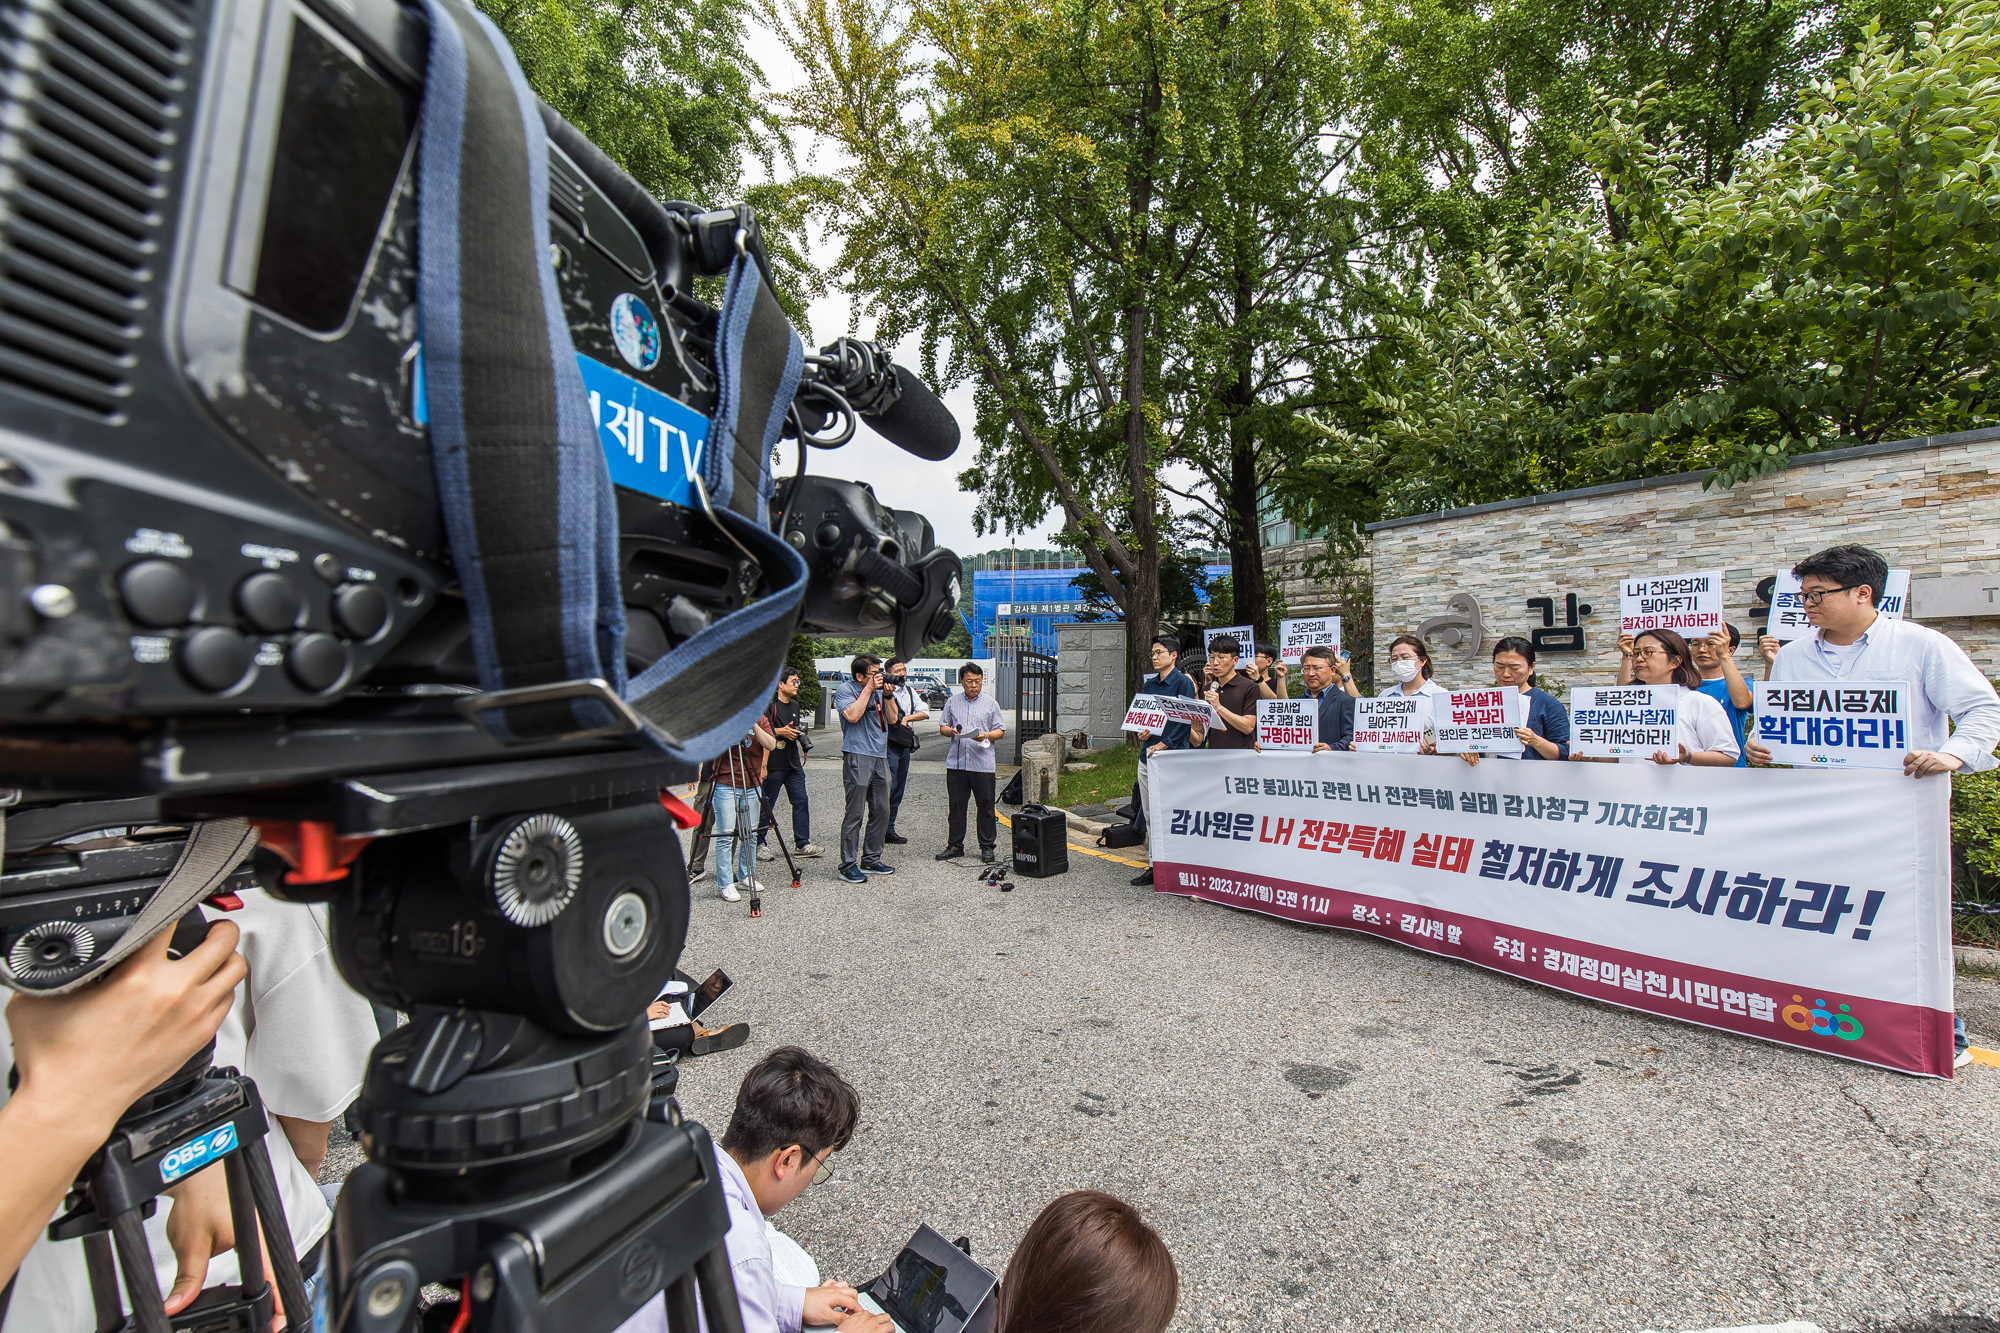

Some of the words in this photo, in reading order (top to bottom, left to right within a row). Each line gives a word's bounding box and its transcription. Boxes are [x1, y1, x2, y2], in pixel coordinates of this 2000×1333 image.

[1627, 583, 1647, 597] LH
[1650, 577, 1709, 596] 전관업체
[1013, 604, 1038, 614] 감사원
[1041, 603, 1071, 614] 제1별관
[1640, 596, 1698, 614] 밀어주기
[1291, 621, 1326, 634] 전관업체
[1622, 616, 1658, 630] 철저히
[1661, 613, 1719, 629] 감사하라!
[1287, 634, 1313, 646] 봐주기
[1314, 632, 1333, 645] 관행
[1281, 647, 1304, 658] 철저히
[1359, 702, 1374, 714] LH
[1375, 700, 1417, 714] 전관업체
[1450, 690, 1504, 709] 부실설계
[1594, 689, 1653, 707] 불공정한
[1766, 689, 1898, 714] 직접시공제
[1268, 702, 1301, 714] 공공사업
[1452, 708, 1505, 726] 부실감리
[1124, 710, 1166, 729] 밝혀내라!
[1259, 715, 1275, 726] 수주
[1277, 715, 1293, 727] 과점
[1295, 715, 1313, 727] 원인
[1367, 716, 1408, 729] 밀어주기
[1573, 709, 1675, 726] 종합심사낙찰제
[1259, 726, 1313, 745] 규명하라!
[1354, 731, 1380, 743] 철저히
[1382, 731, 1421, 744] 감사하라!
[1438, 727, 1469, 741] 원인은
[1579, 728, 1671, 746] 즉각개선하라!
[1758, 715, 1905, 749] 확대하라!
[1234, 777, 1259, 795] 검단
[1263, 778, 1319, 799] 붕괴사고
[1322, 780, 1353, 801] 관련
[1356, 783, 1380, 803] LH
[1385, 785, 1455, 811] 전관특혜
[1459, 791, 1498, 815] 실태
[1502, 794, 1589, 823] 감사청구
[1594, 801, 1708, 836] 기자회견]
[1170, 808, 1255, 842] 감사원은
[1258, 815, 1296, 846] LH
[1297, 818, 1406, 863] 전관특혜
[1411, 832, 1475, 874] 실태
[1478, 839, 1625, 899] 철저하게
[1625, 860, 1887, 942] 조사하라!
[1178, 871, 1199, 888] 일시
[1208, 876, 1273, 903] 2023.7.31(월)
[1275, 888, 1298, 909] 오전
[1301, 894, 1330, 915] 11시
[1351, 903, 1381, 926] 장소
[1400, 913, 1443, 941] 감사원
[1447, 924, 1463, 946] 앞
[1493, 935, 1526, 963] 주최
[1543, 947, 1777, 1023] 경제정의실천시민연합
[163, 1139, 208, 1172] OBS
